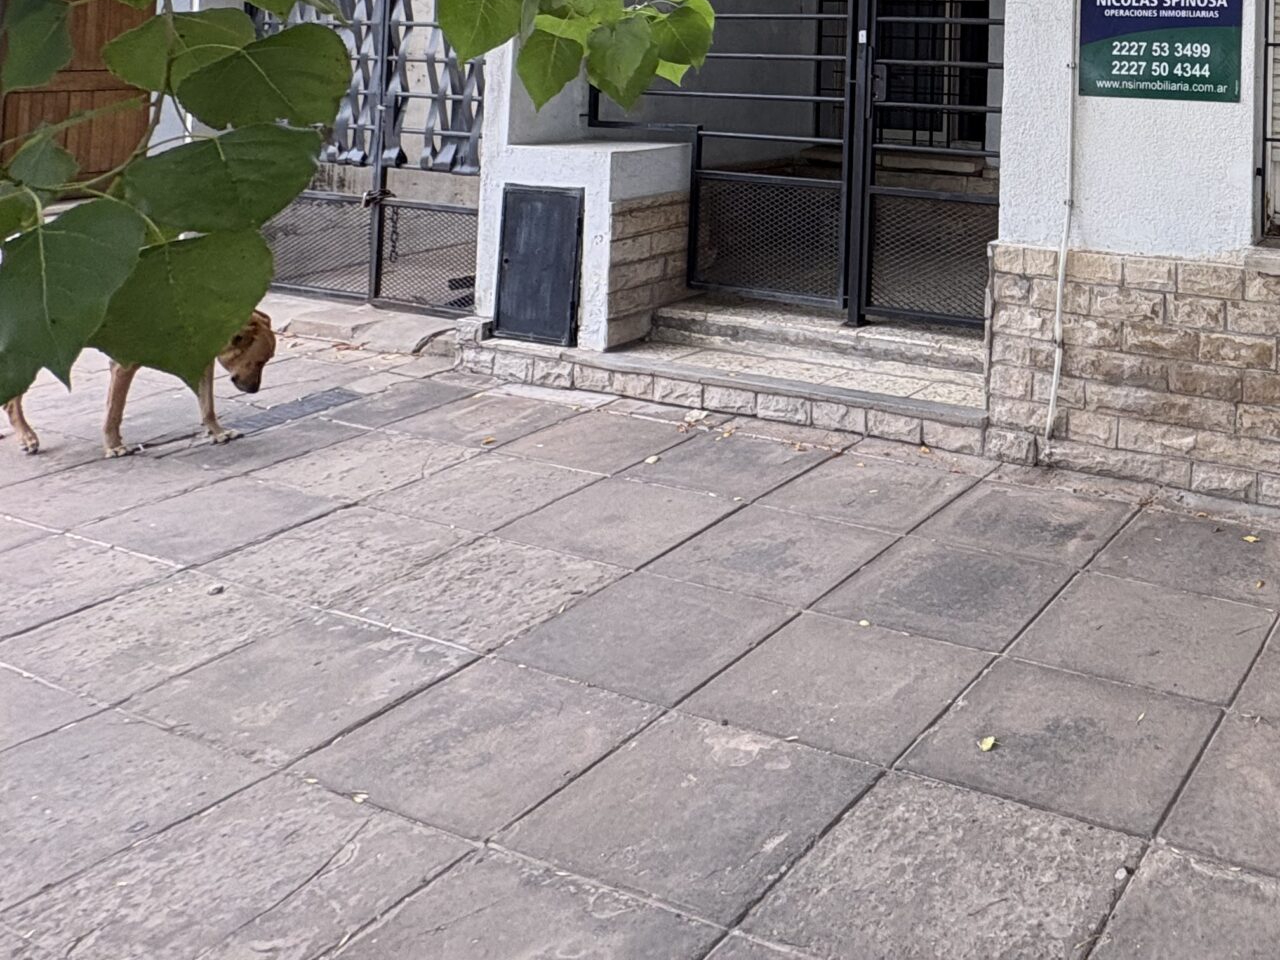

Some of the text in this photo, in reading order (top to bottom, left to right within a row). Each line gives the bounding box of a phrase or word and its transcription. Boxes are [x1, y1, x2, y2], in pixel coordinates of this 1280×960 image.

[1104, 9, 1219, 18] OPERACIONES INMOBILIARIAS
[1112, 41, 1211, 58] 2227 53 3499
[1111, 61, 1210, 78] 2227 50 4344
[1096, 79, 1228, 93] www.nsinmobiliaria.com.ar
